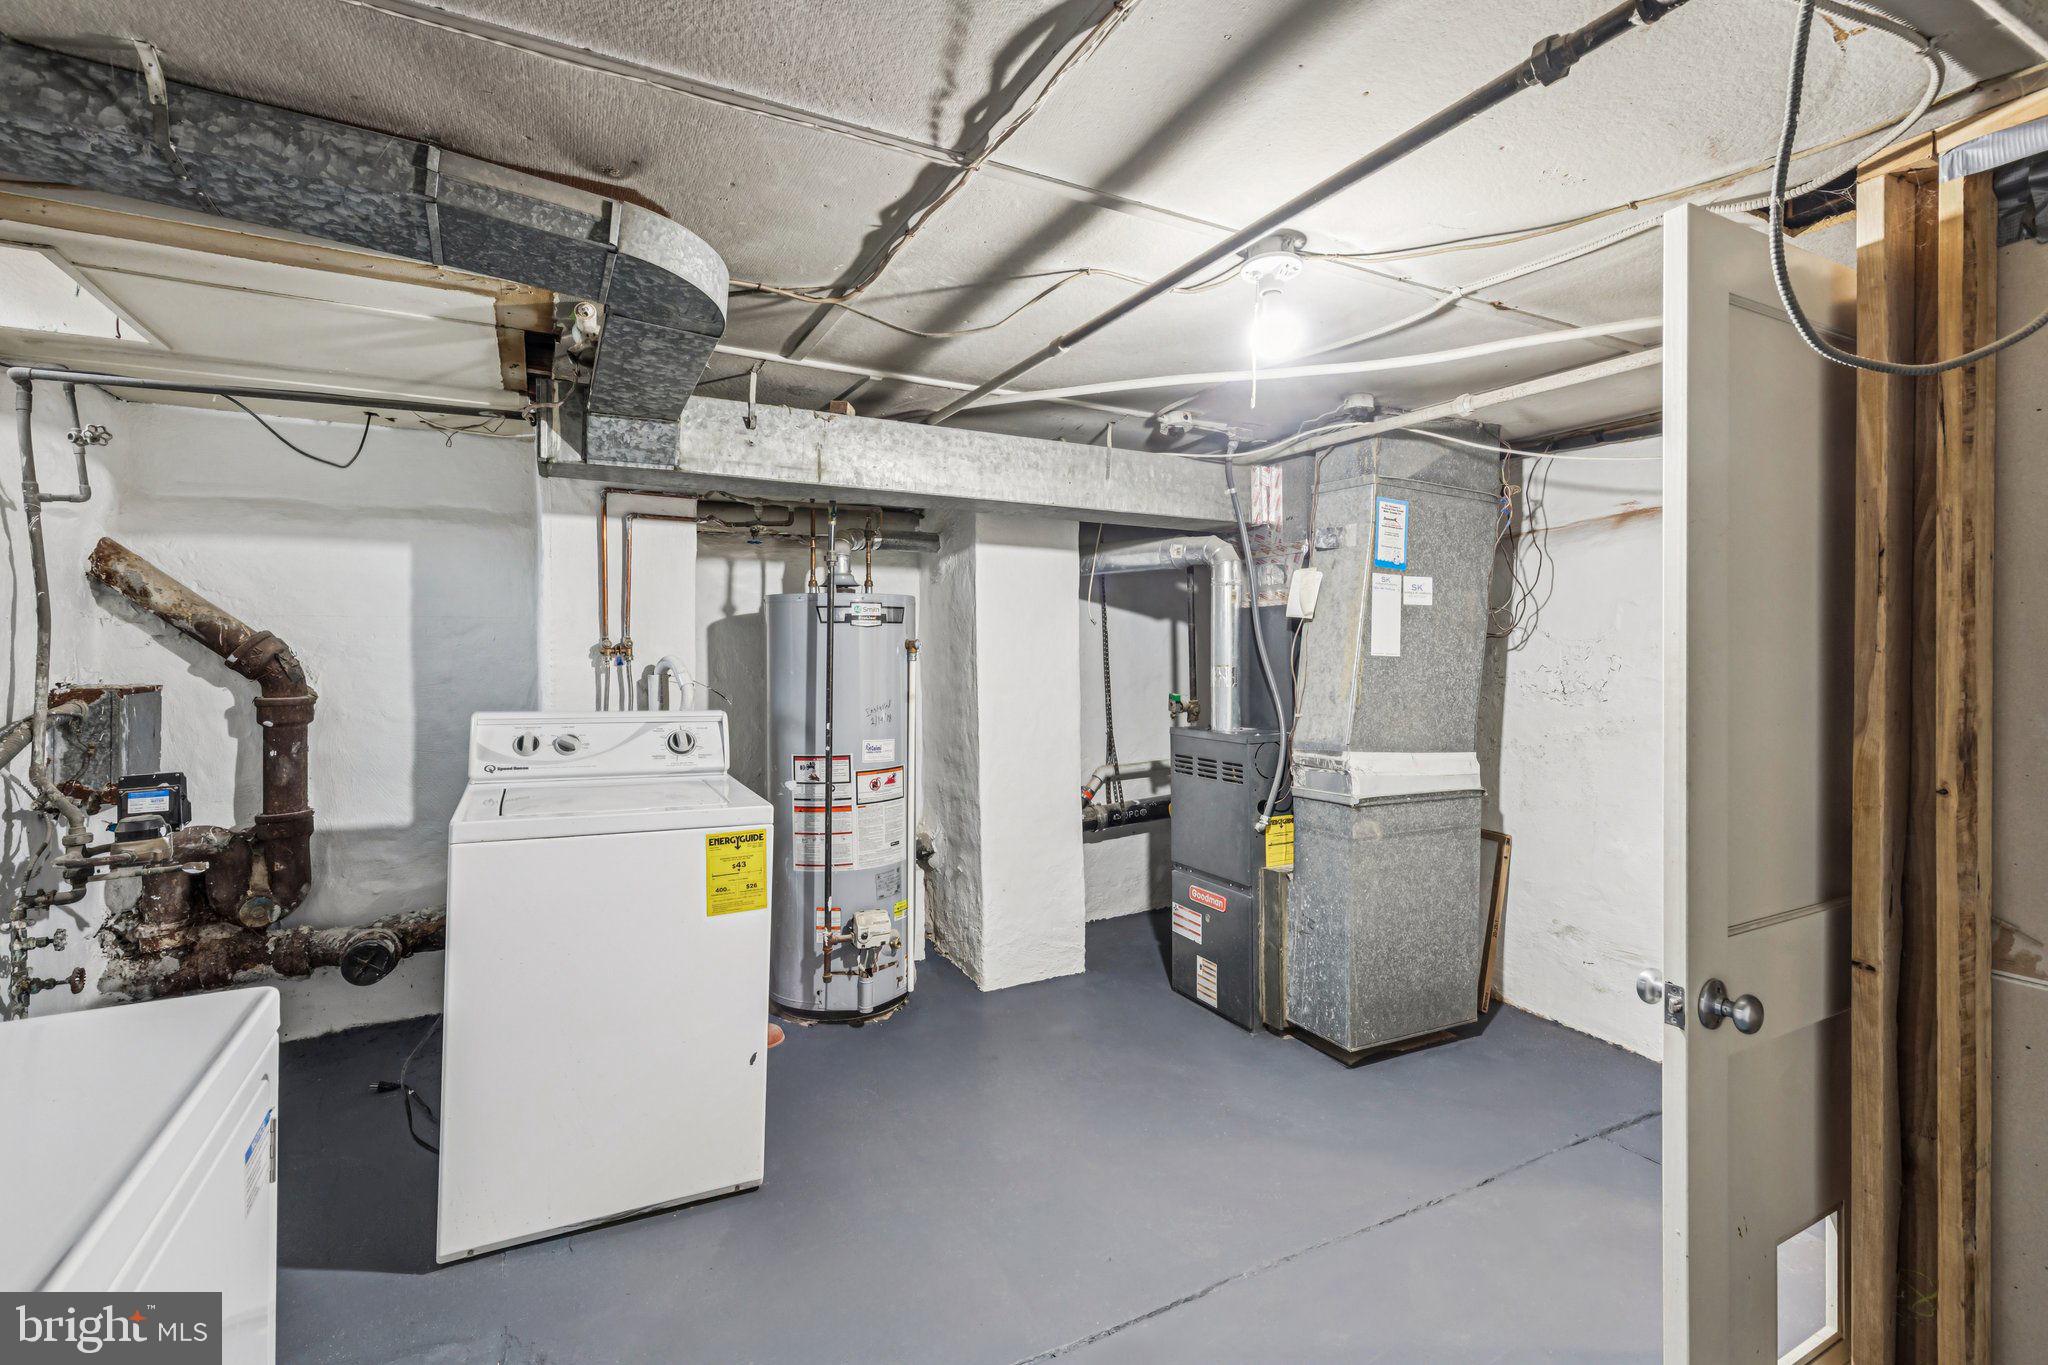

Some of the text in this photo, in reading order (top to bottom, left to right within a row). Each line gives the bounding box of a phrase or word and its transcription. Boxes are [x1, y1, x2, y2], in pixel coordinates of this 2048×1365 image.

[709, 834, 764, 847] ENERGYGUIDE
[732, 861, 746, 869] $43
[1191, 889, 1223, 907] Goodman
